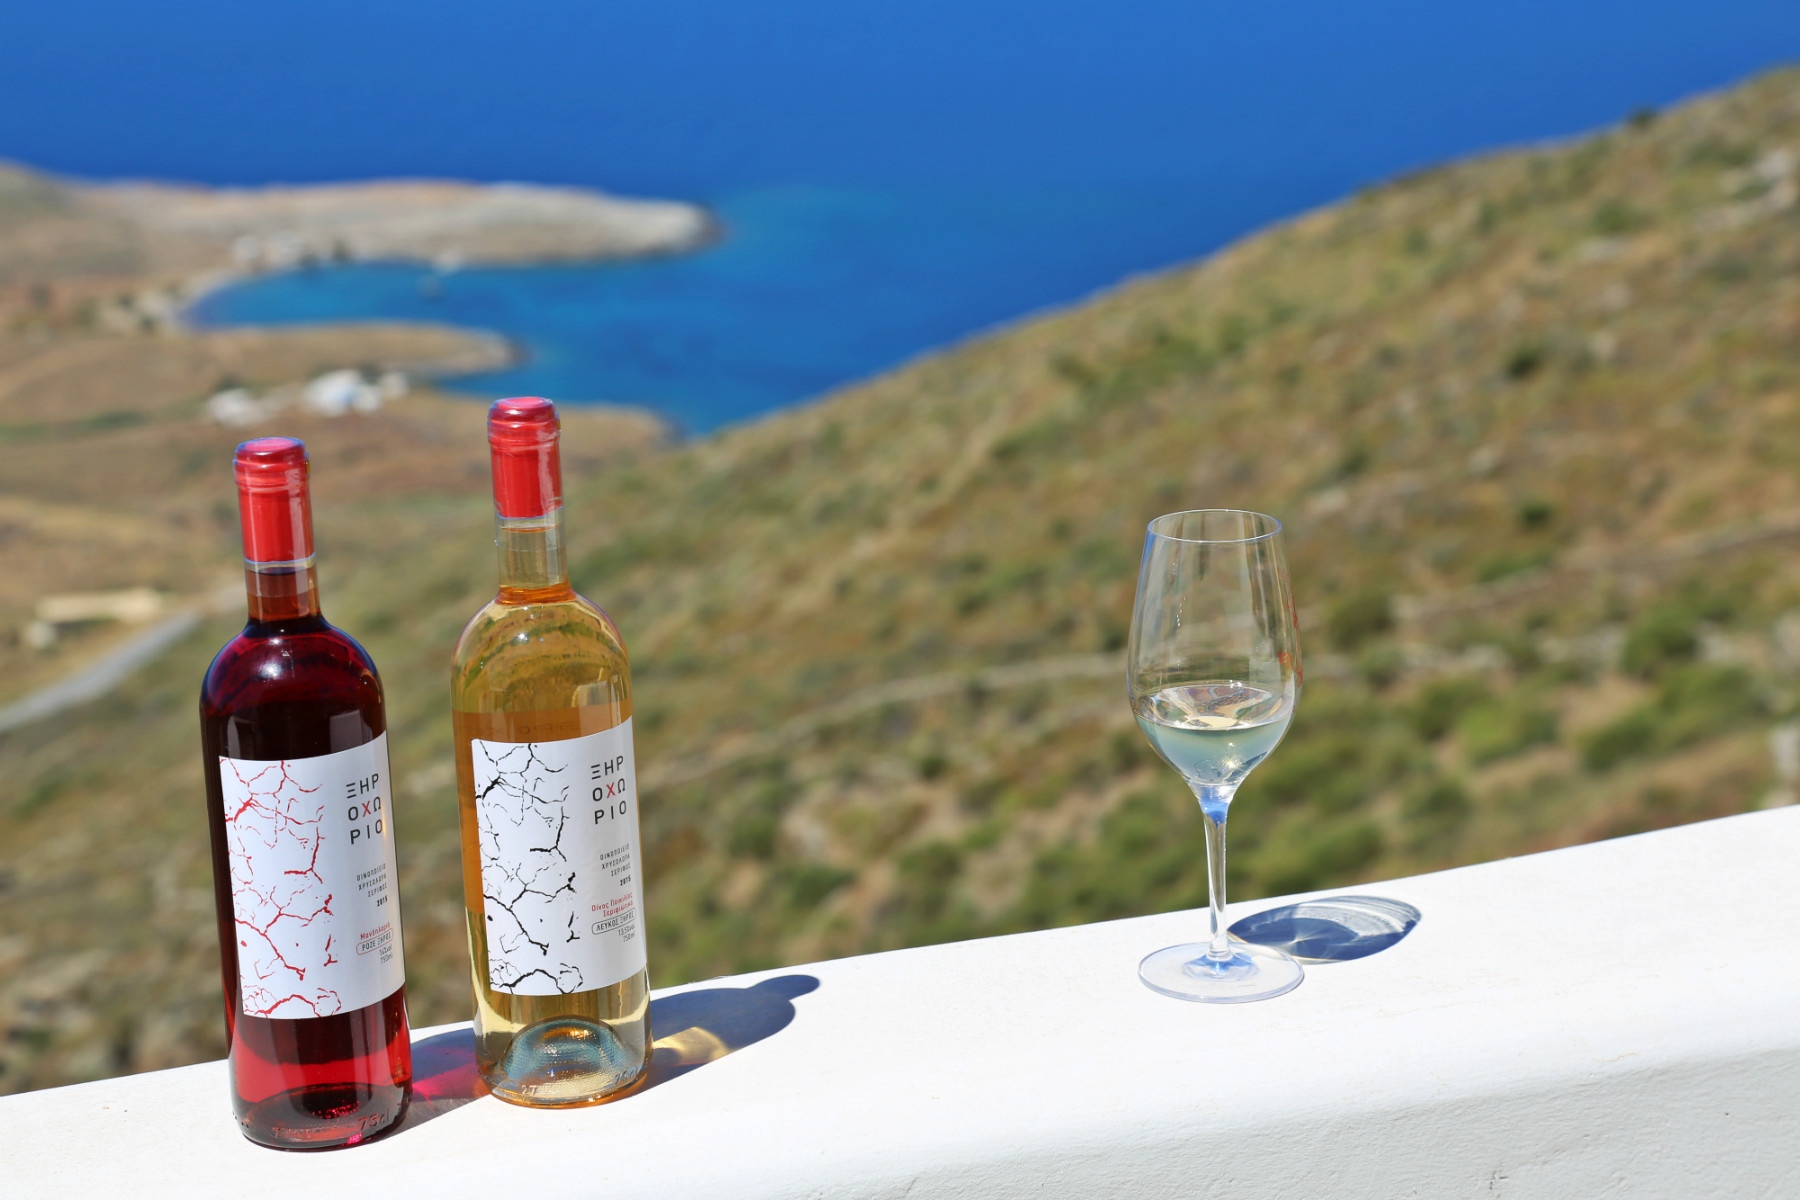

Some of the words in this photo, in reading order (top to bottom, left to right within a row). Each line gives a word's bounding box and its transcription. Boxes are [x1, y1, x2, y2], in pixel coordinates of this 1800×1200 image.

[591, 755, 624, 780] ΞΗΡ
[346, 773, 379, 799] ΞΗΡ
[592, 778, 626, 802] ΟΧΩ
[348, 796, 381, 821] ΟΧΩ
[594, 800, 627, 825] ΡΙΟ
[350, 819, 383, 845] ΡΙΟ
